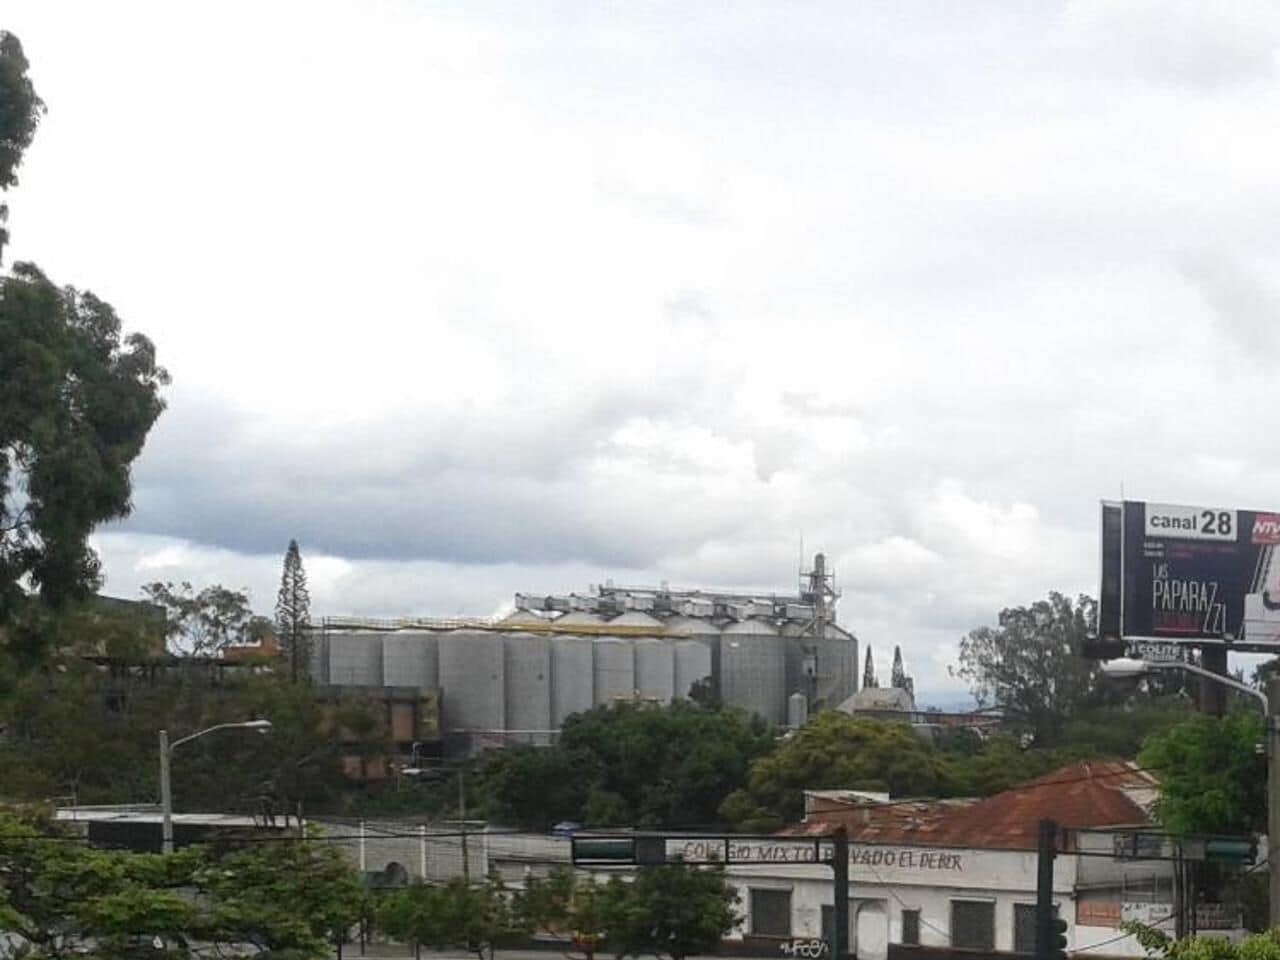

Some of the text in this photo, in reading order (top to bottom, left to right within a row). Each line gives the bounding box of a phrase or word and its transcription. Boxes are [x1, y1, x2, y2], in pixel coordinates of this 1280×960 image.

[1150, 510, 1231, 535] canal 28
[1152, 563, 1169, 579] LAS
[824, 847, 895, 866] PVADO
[899, 850, 917, 868] EL
